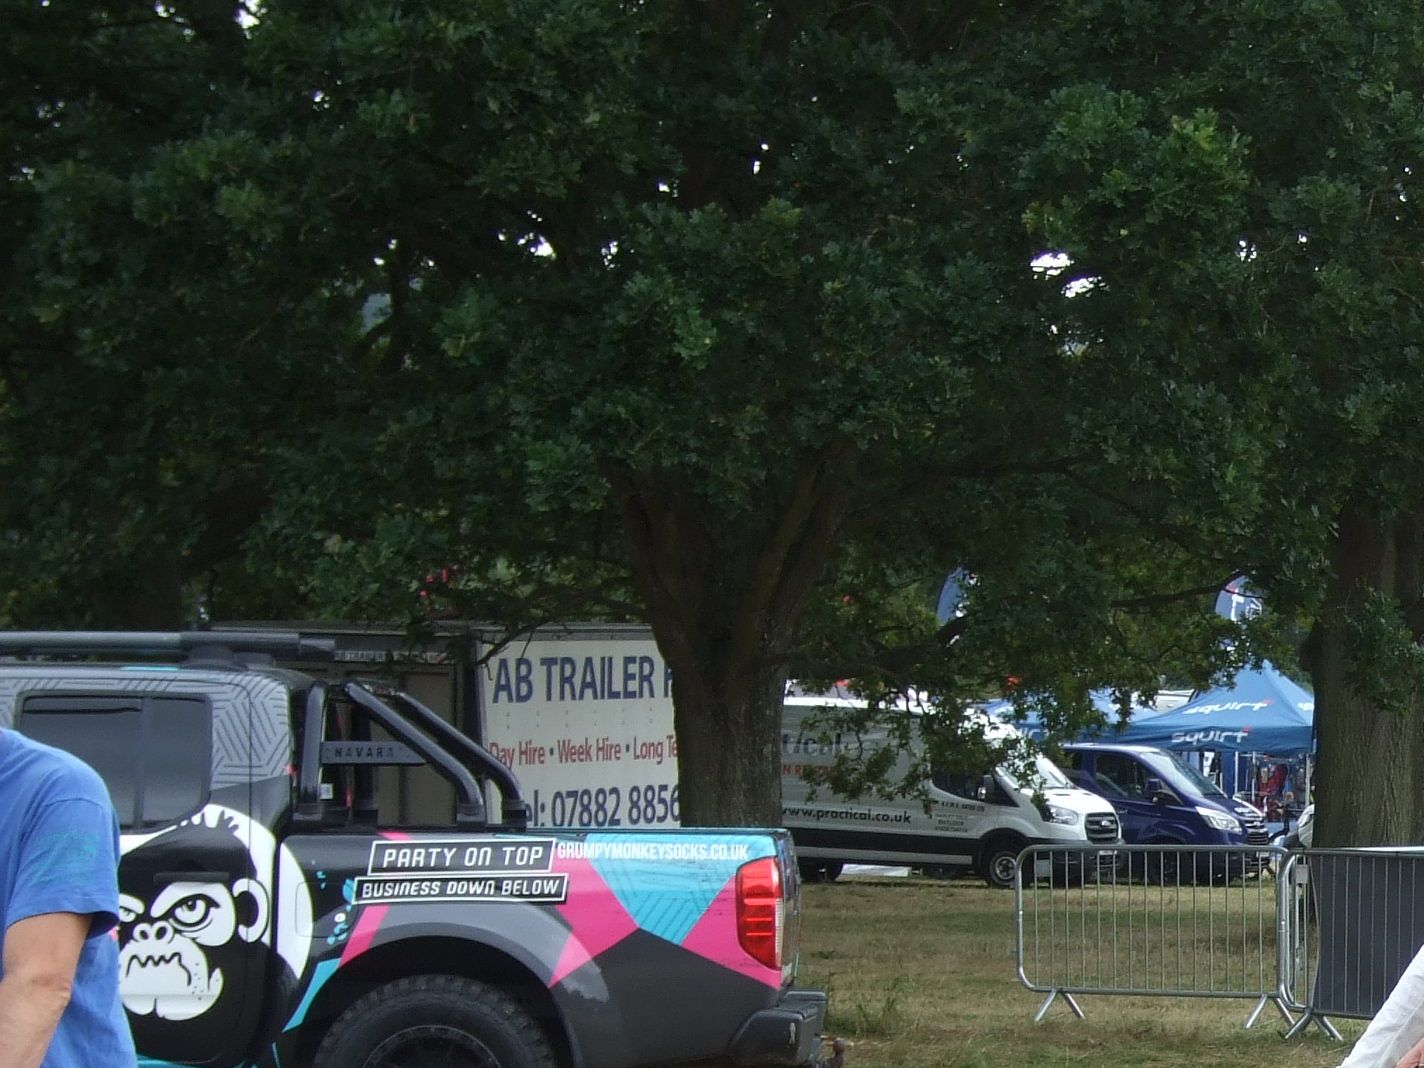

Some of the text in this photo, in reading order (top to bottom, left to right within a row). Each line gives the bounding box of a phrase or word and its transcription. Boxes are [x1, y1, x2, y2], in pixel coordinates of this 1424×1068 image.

[492, 658, 534, 704] AB
[539, 655, 655, 702] TRAILER
[1182, 698, 1272, 716] squirt
[1171, 725, 1252, 744] squirt
[335, 747, 395, 759] NAVARA
[488, 741, 515, 769] Day
[518, 738, 545, 765] Hire
[556, 736, 593, 764] Week
[595, 736, 621, 761] Hire
[632, 735, 664, 765] Long
[525, 784, 680, 827] el: 07882 8856
[382, 848, 456, 868] PARTY
[502, 846, 544, 866] TOP
[557, 842, 749, 860] GRUMPYMONKEYSOCKS.CO.UK
[361, 879, 561, 898] BUSINESS DOWN BELOW
